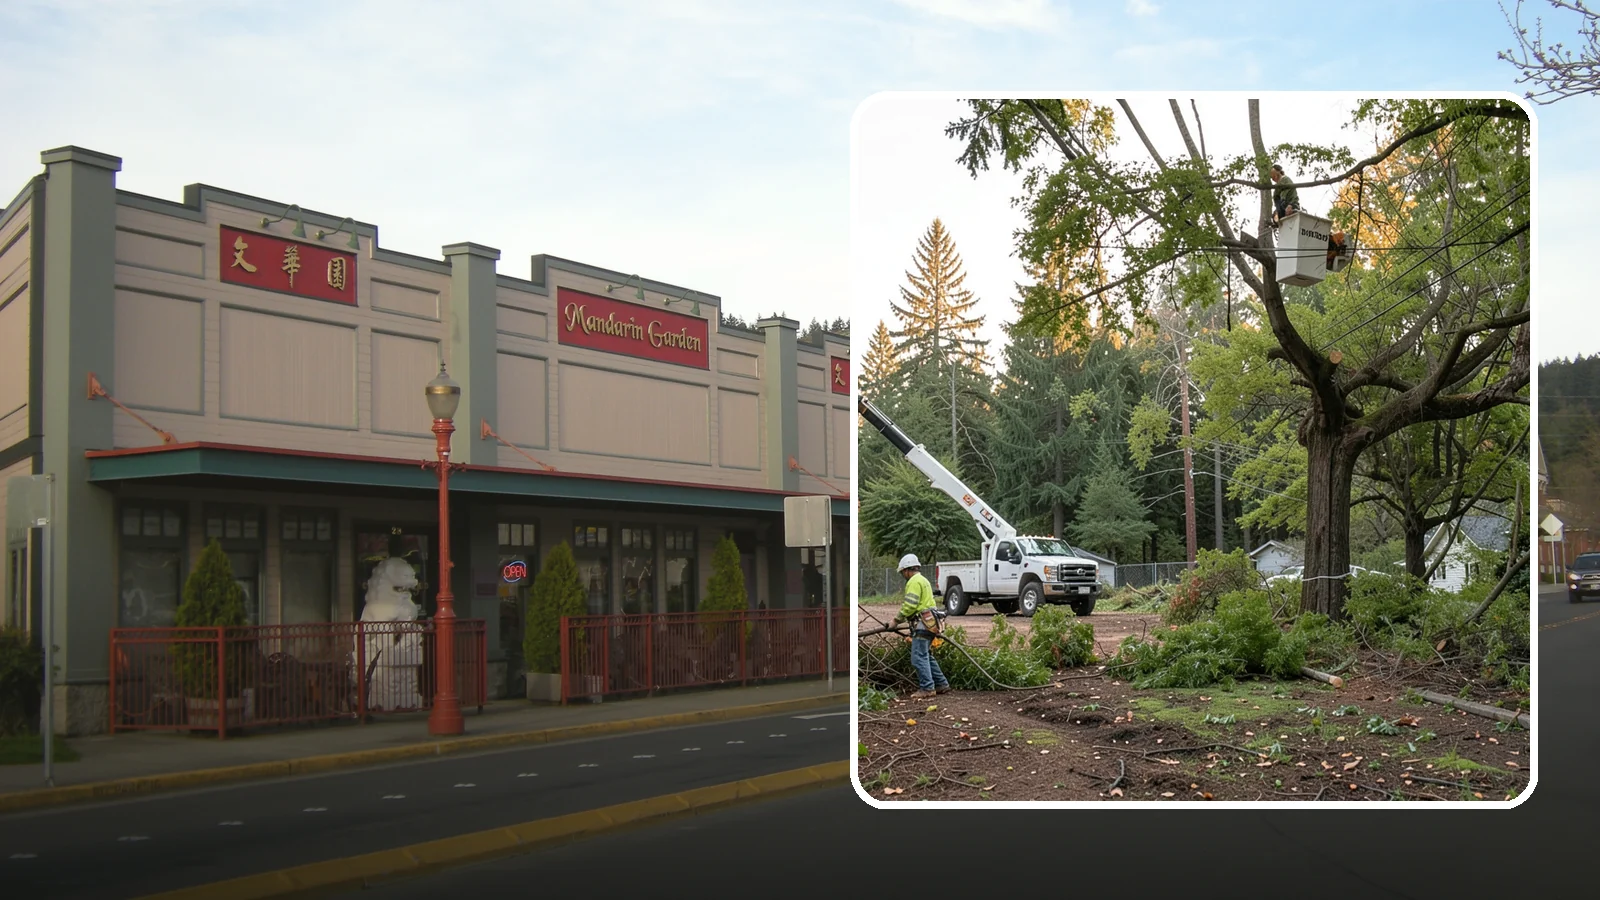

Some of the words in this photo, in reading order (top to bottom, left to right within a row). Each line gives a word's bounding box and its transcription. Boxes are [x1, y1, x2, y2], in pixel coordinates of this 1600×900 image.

[230, 235, 346, 291] 文華園
[564, 302, 644, 341] Mandarin
[647, 320, 702, 352] Garden
[503, 565, 527, 578] OPEN
